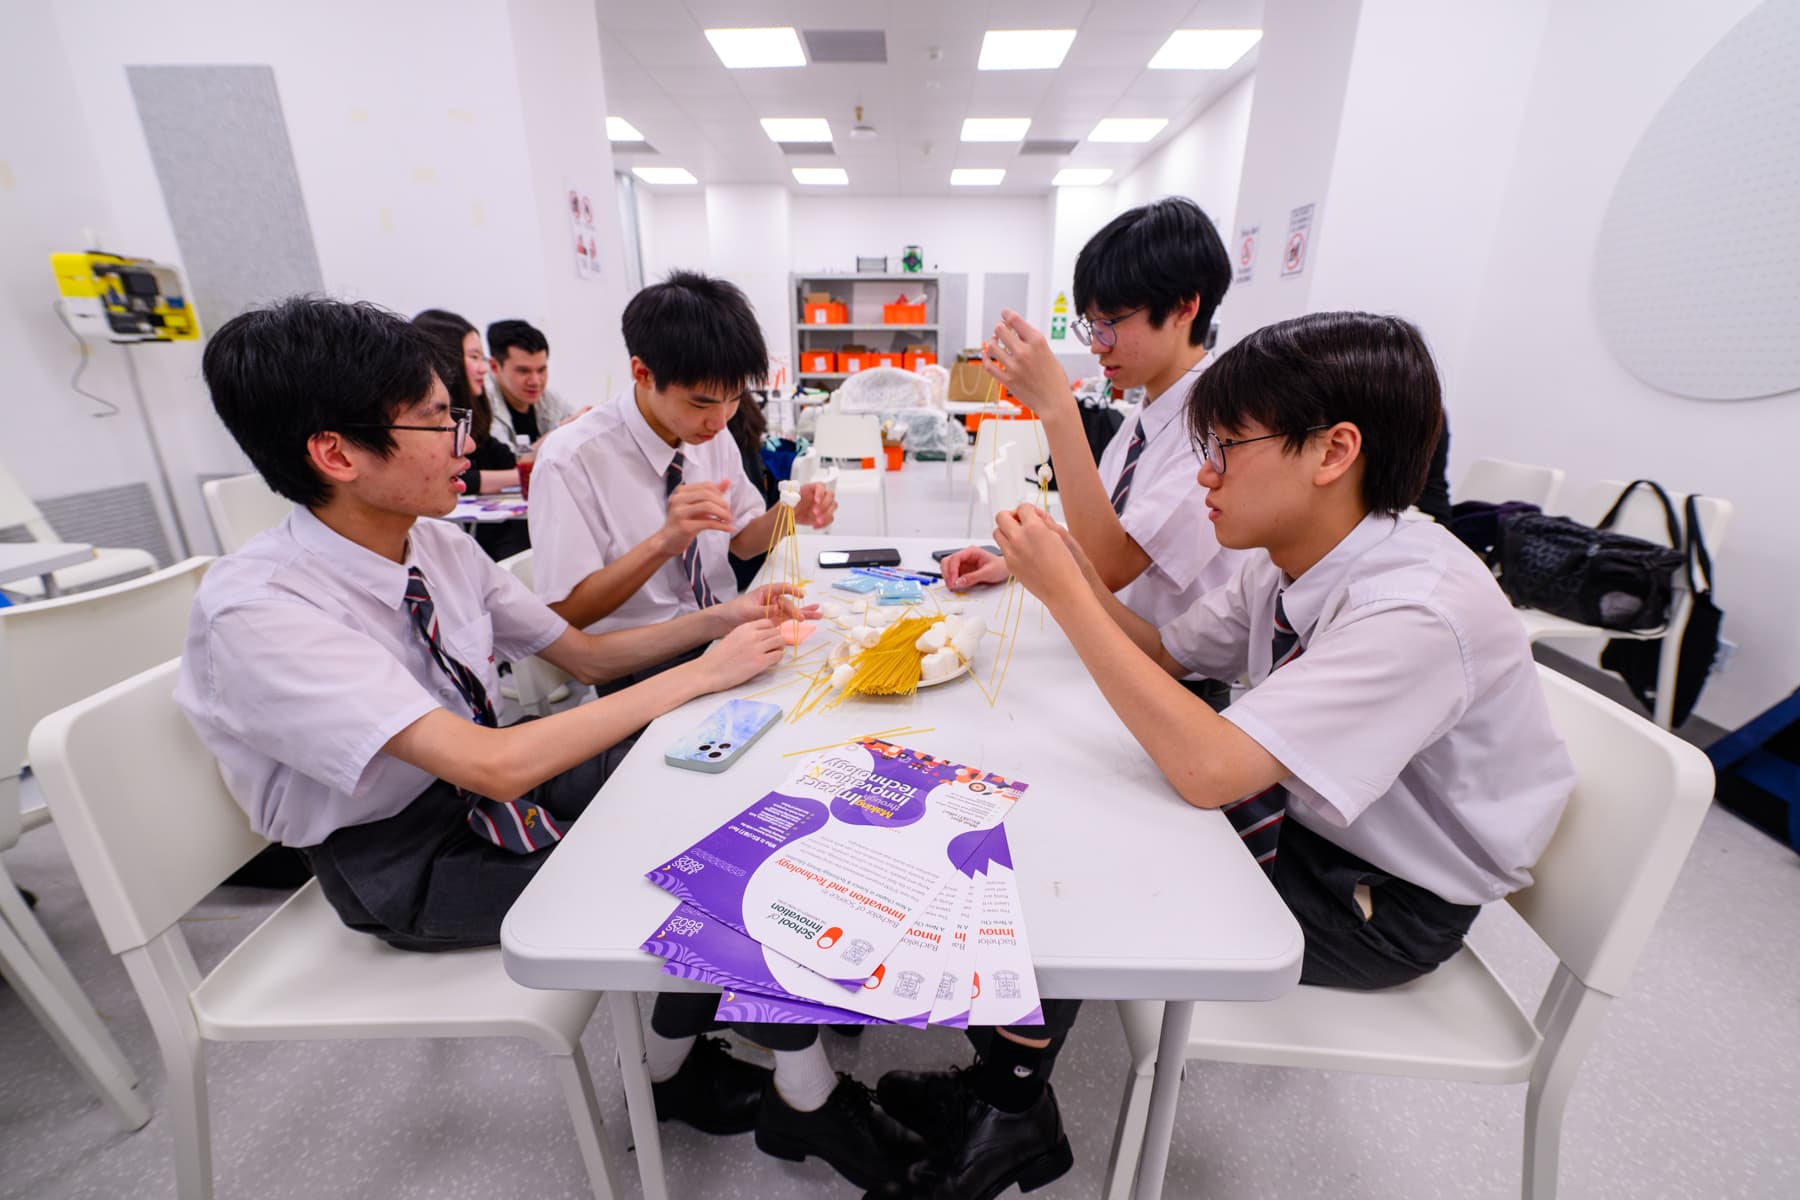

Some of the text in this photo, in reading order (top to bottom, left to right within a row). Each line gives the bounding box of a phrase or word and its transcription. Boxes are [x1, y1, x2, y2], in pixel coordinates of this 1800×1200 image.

[822, 768, 910, 806] Innovation
[824, 757, 918, 798] Technology
[796, 774, 862, 806] Impact
[855, 800, 894, 819] Making
[863, 794, 900, 811] through
[776, 858, 828, 887] Technology
[828, 880, 849, 894] and
[829, 893, 855, 909] Science
[850, 891, 906, 922] Innovation
[854, 904, 866, 913] of
[671, 915, 704, 931] 6602
[771, 902, 823, 933] Innovation
[866, 909, 900, 929] Bachelor
[777, 918, 816, 941] School
[905, 928, 941, 944] Innov
[979, 928, 1015, 938] Innov
